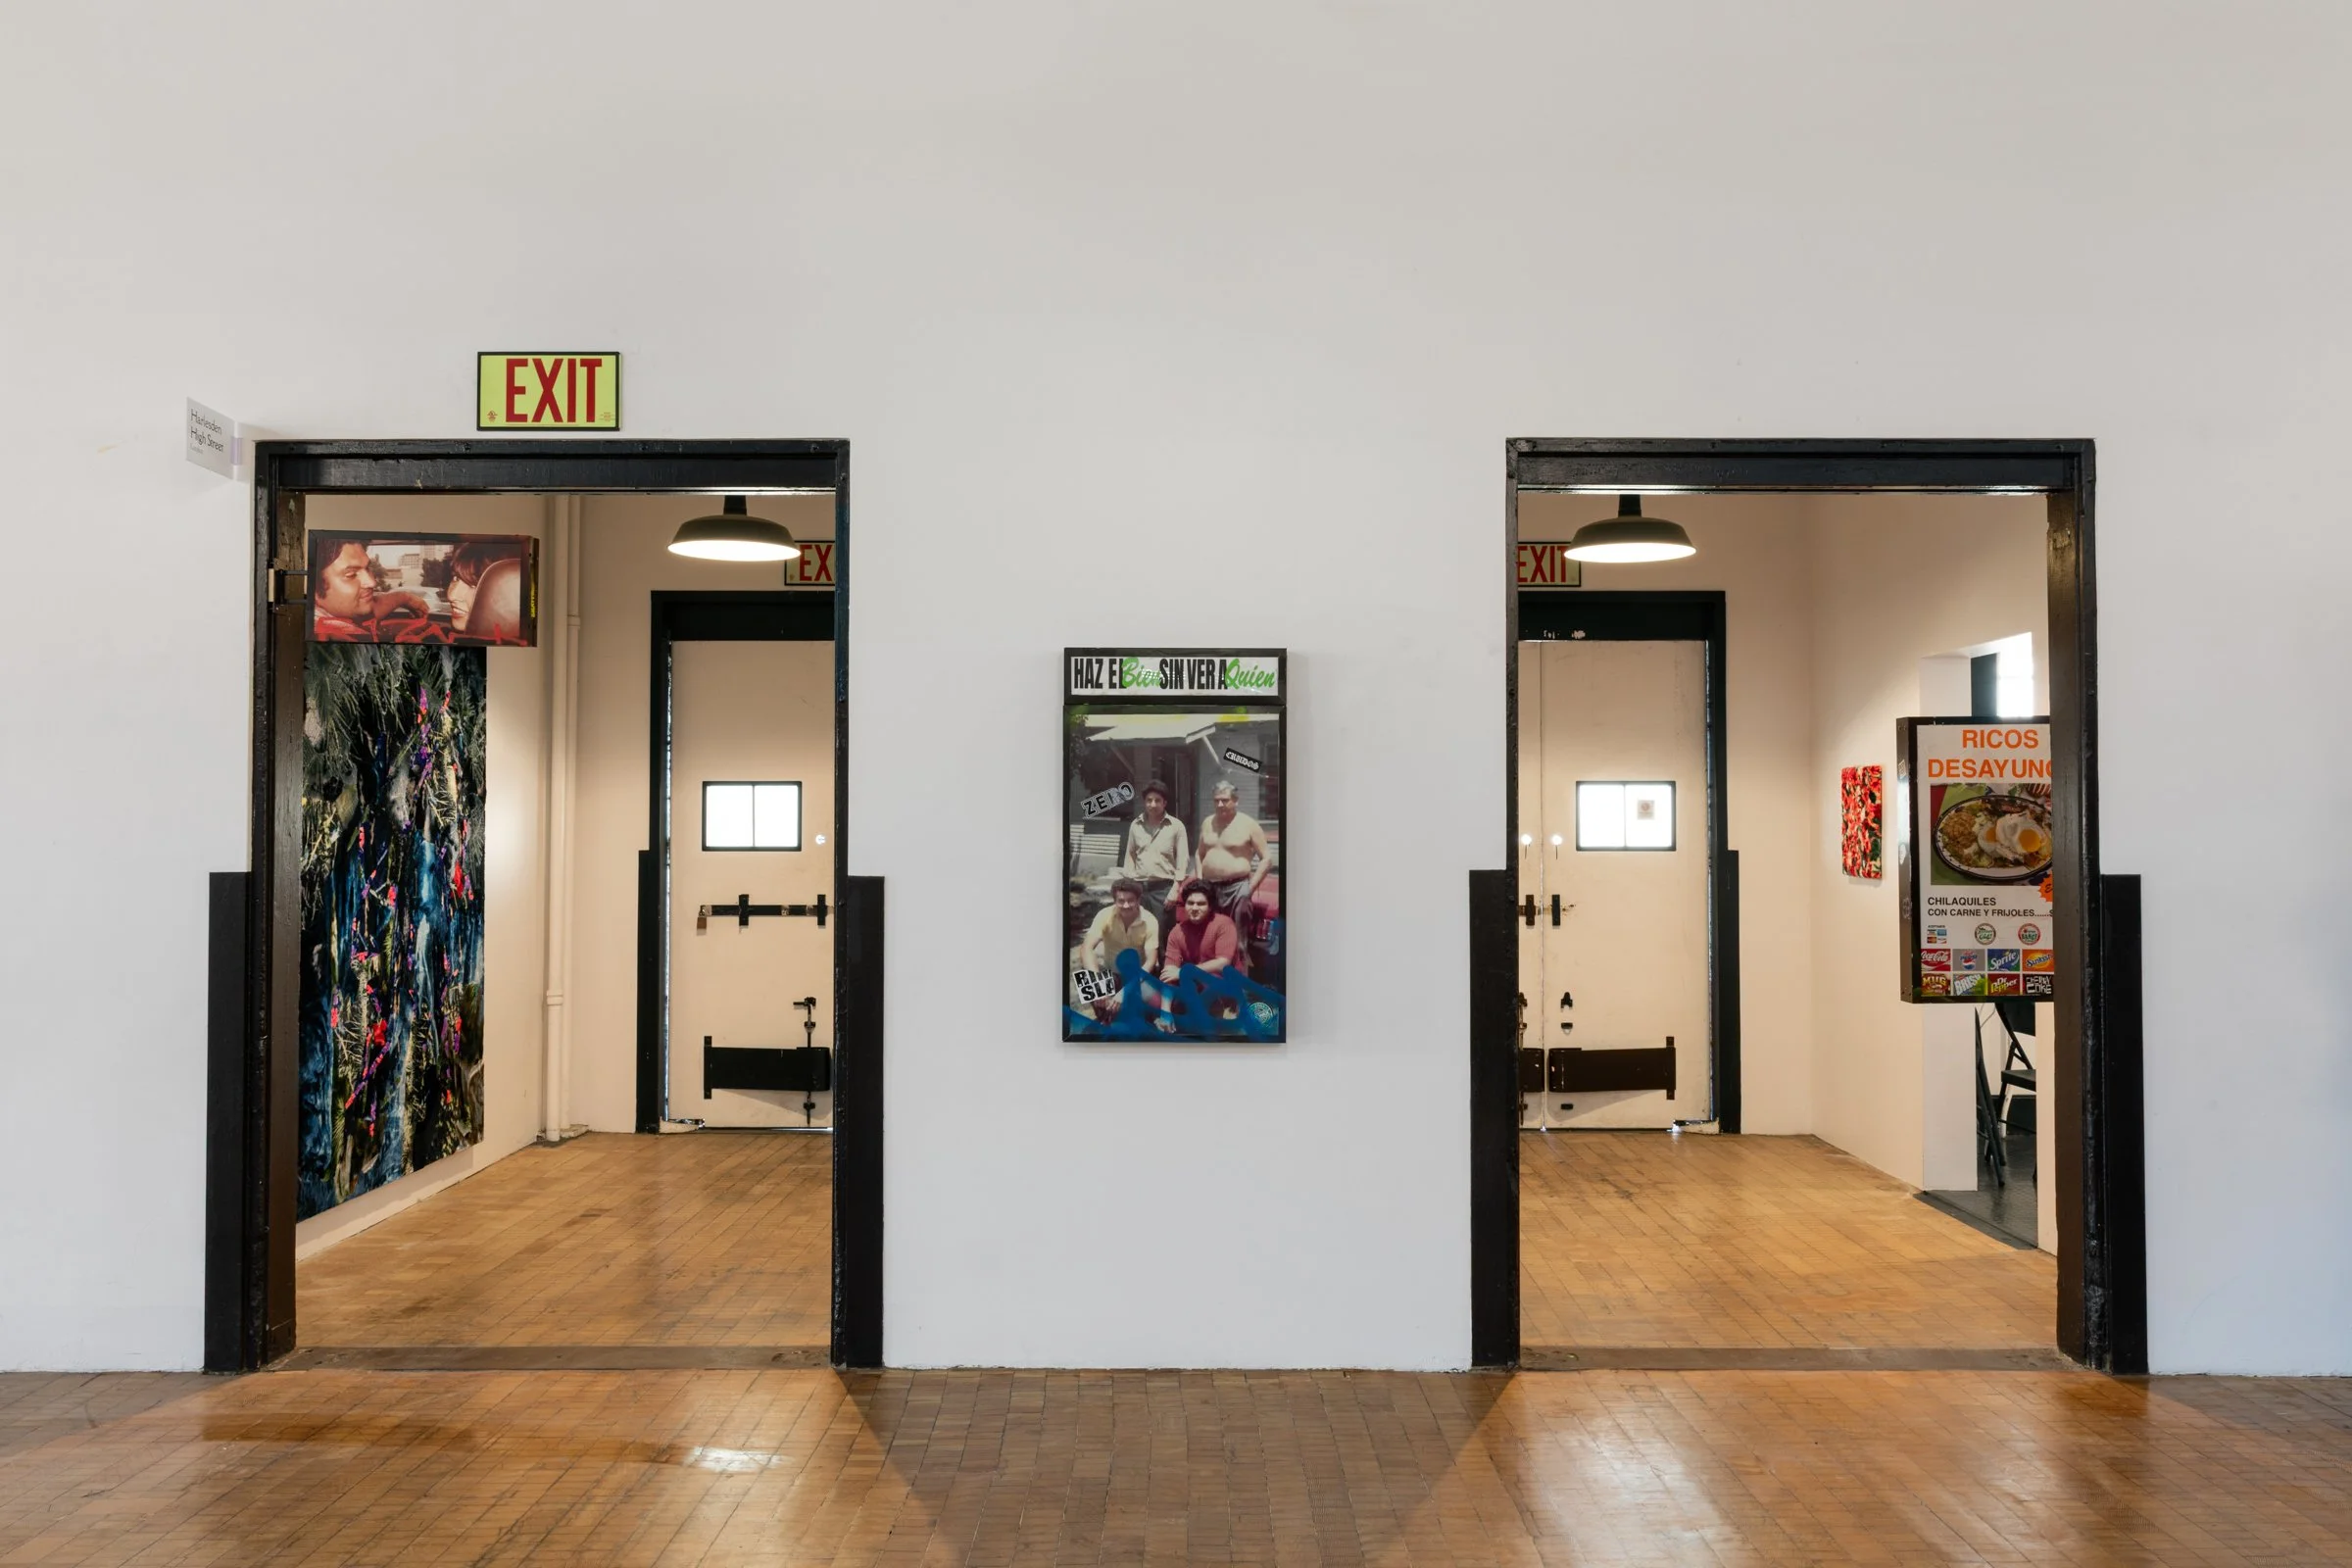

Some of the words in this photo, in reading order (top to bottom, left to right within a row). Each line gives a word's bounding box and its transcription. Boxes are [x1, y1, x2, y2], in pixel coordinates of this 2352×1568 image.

[506, 358, 603, 423] EXIT
[190, 425, 207, 446] High
[799, 544, 833, 581] EX
[1517, 545, 1569, 582] EXIT
[1074, 658, 1103, 689] HAZ
[1108, 658, 1127, 689] EL
[1158, 658, 1185, 690] SIN
[1187, 659, 1215, 690] VER
[1218, 659, 1228, 690] A
[1224, 658, 1276, 689] Quien
[1962, 729, 2038, 749] RICOS
[1928, 897, 1996, 906] CHILAQUILES
[1928, 908, 1947, 917] CON
[1949, 908, 1981, 917] CARNE
[1989, 952, 2017, 970] Sprite
